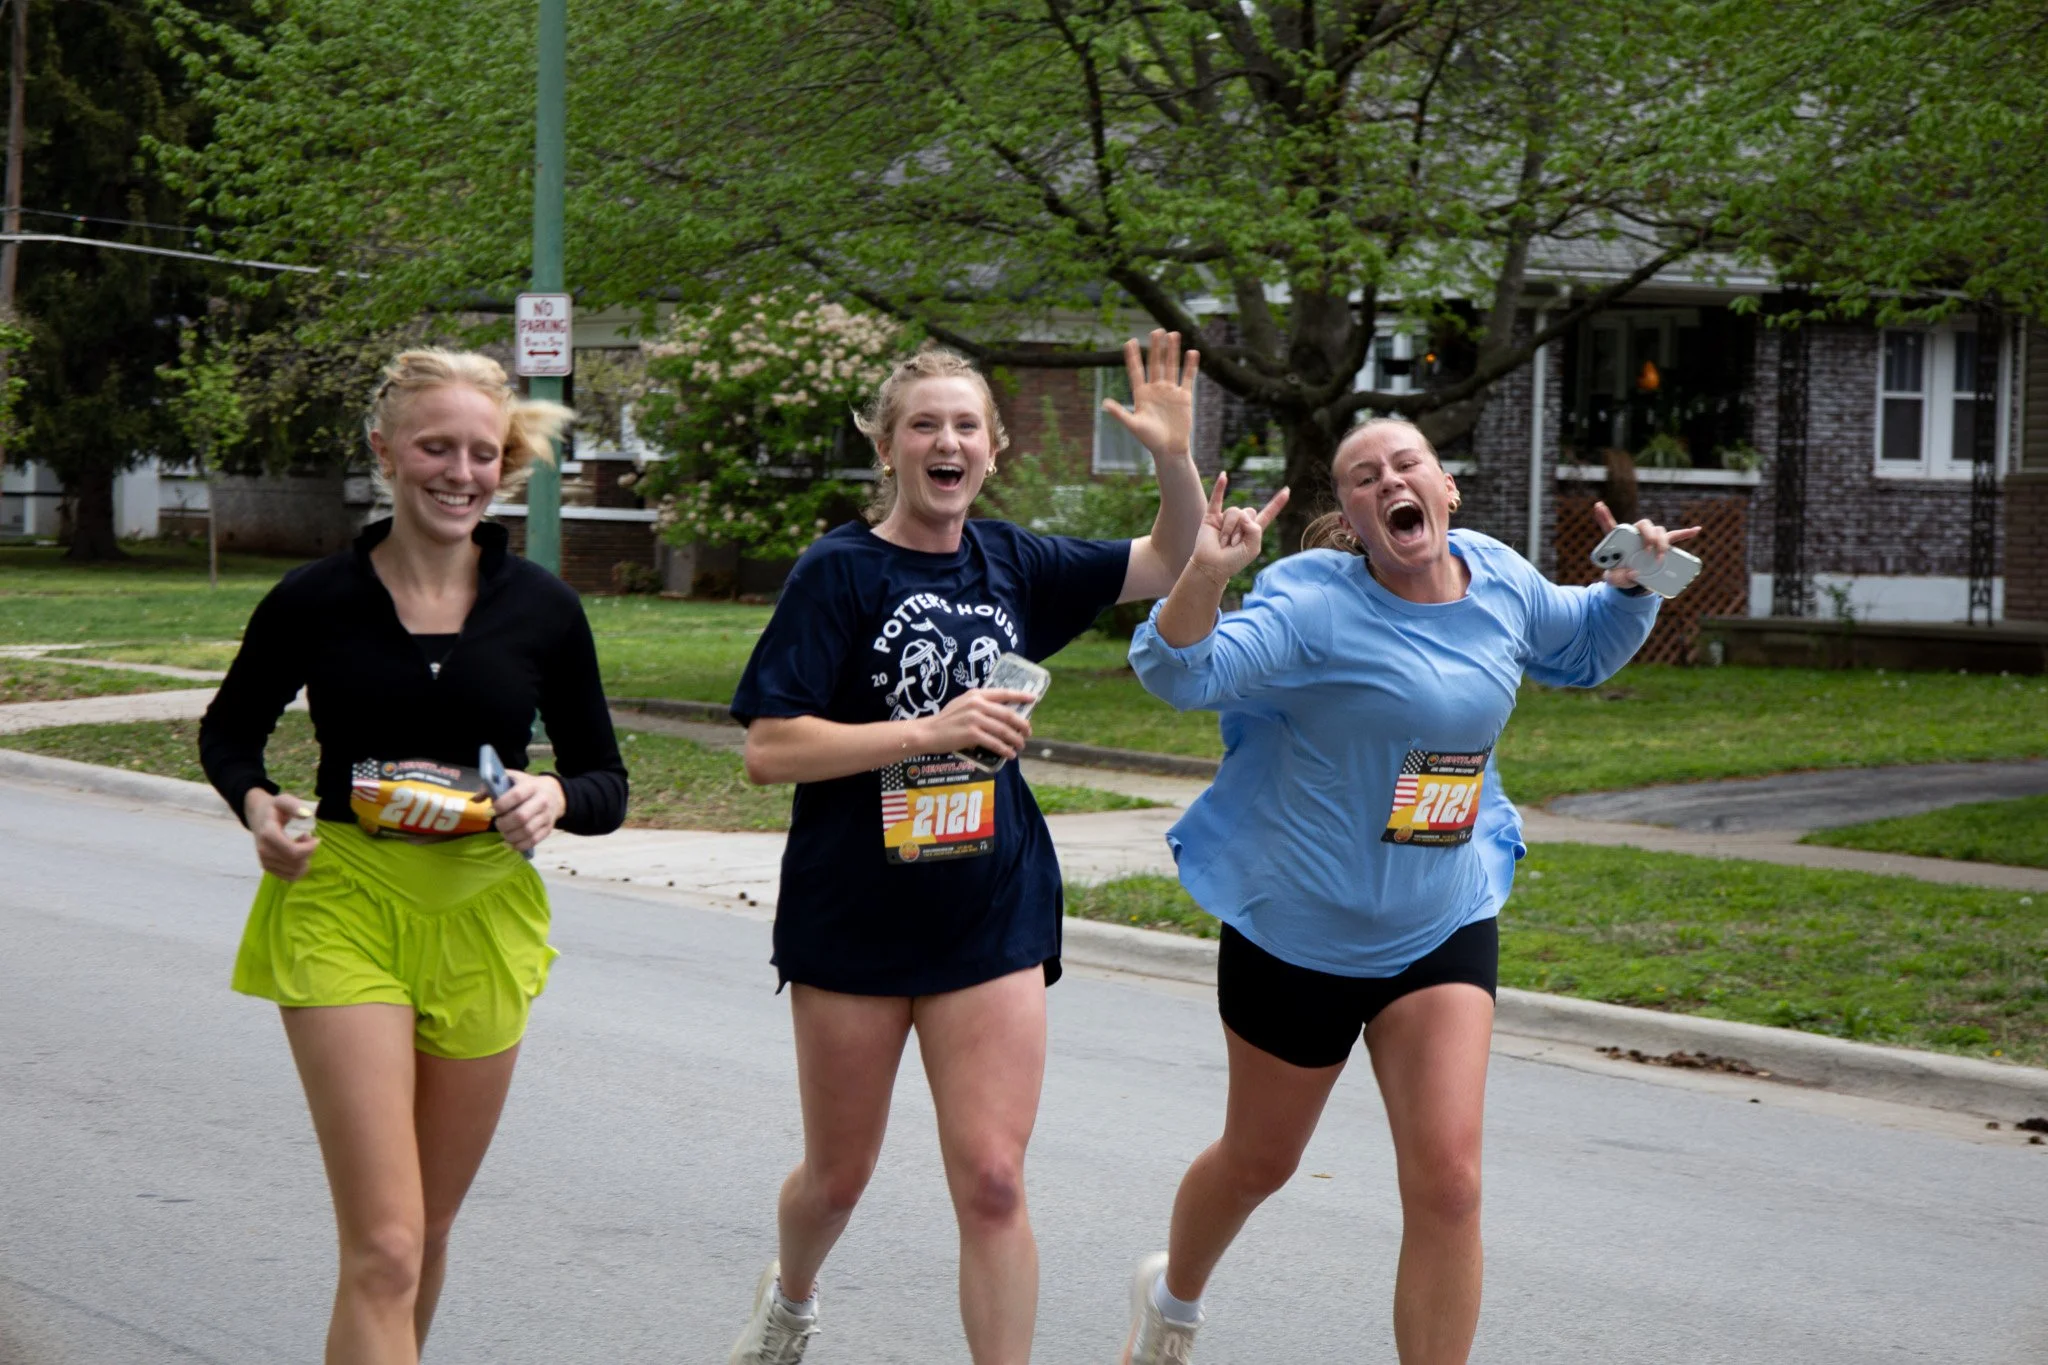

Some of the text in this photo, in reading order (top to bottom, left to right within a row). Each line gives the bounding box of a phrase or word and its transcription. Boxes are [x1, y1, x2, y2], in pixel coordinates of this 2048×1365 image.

[533, 301, 553, 317] NO
[519, 319, 568, 333] PARKING
[956, 603, 1020, 649] HOUSE
[871, 672, 888, 688] 20
[379, 786, 467, 833] 2115
[911, 789, 984, 838] 2120
